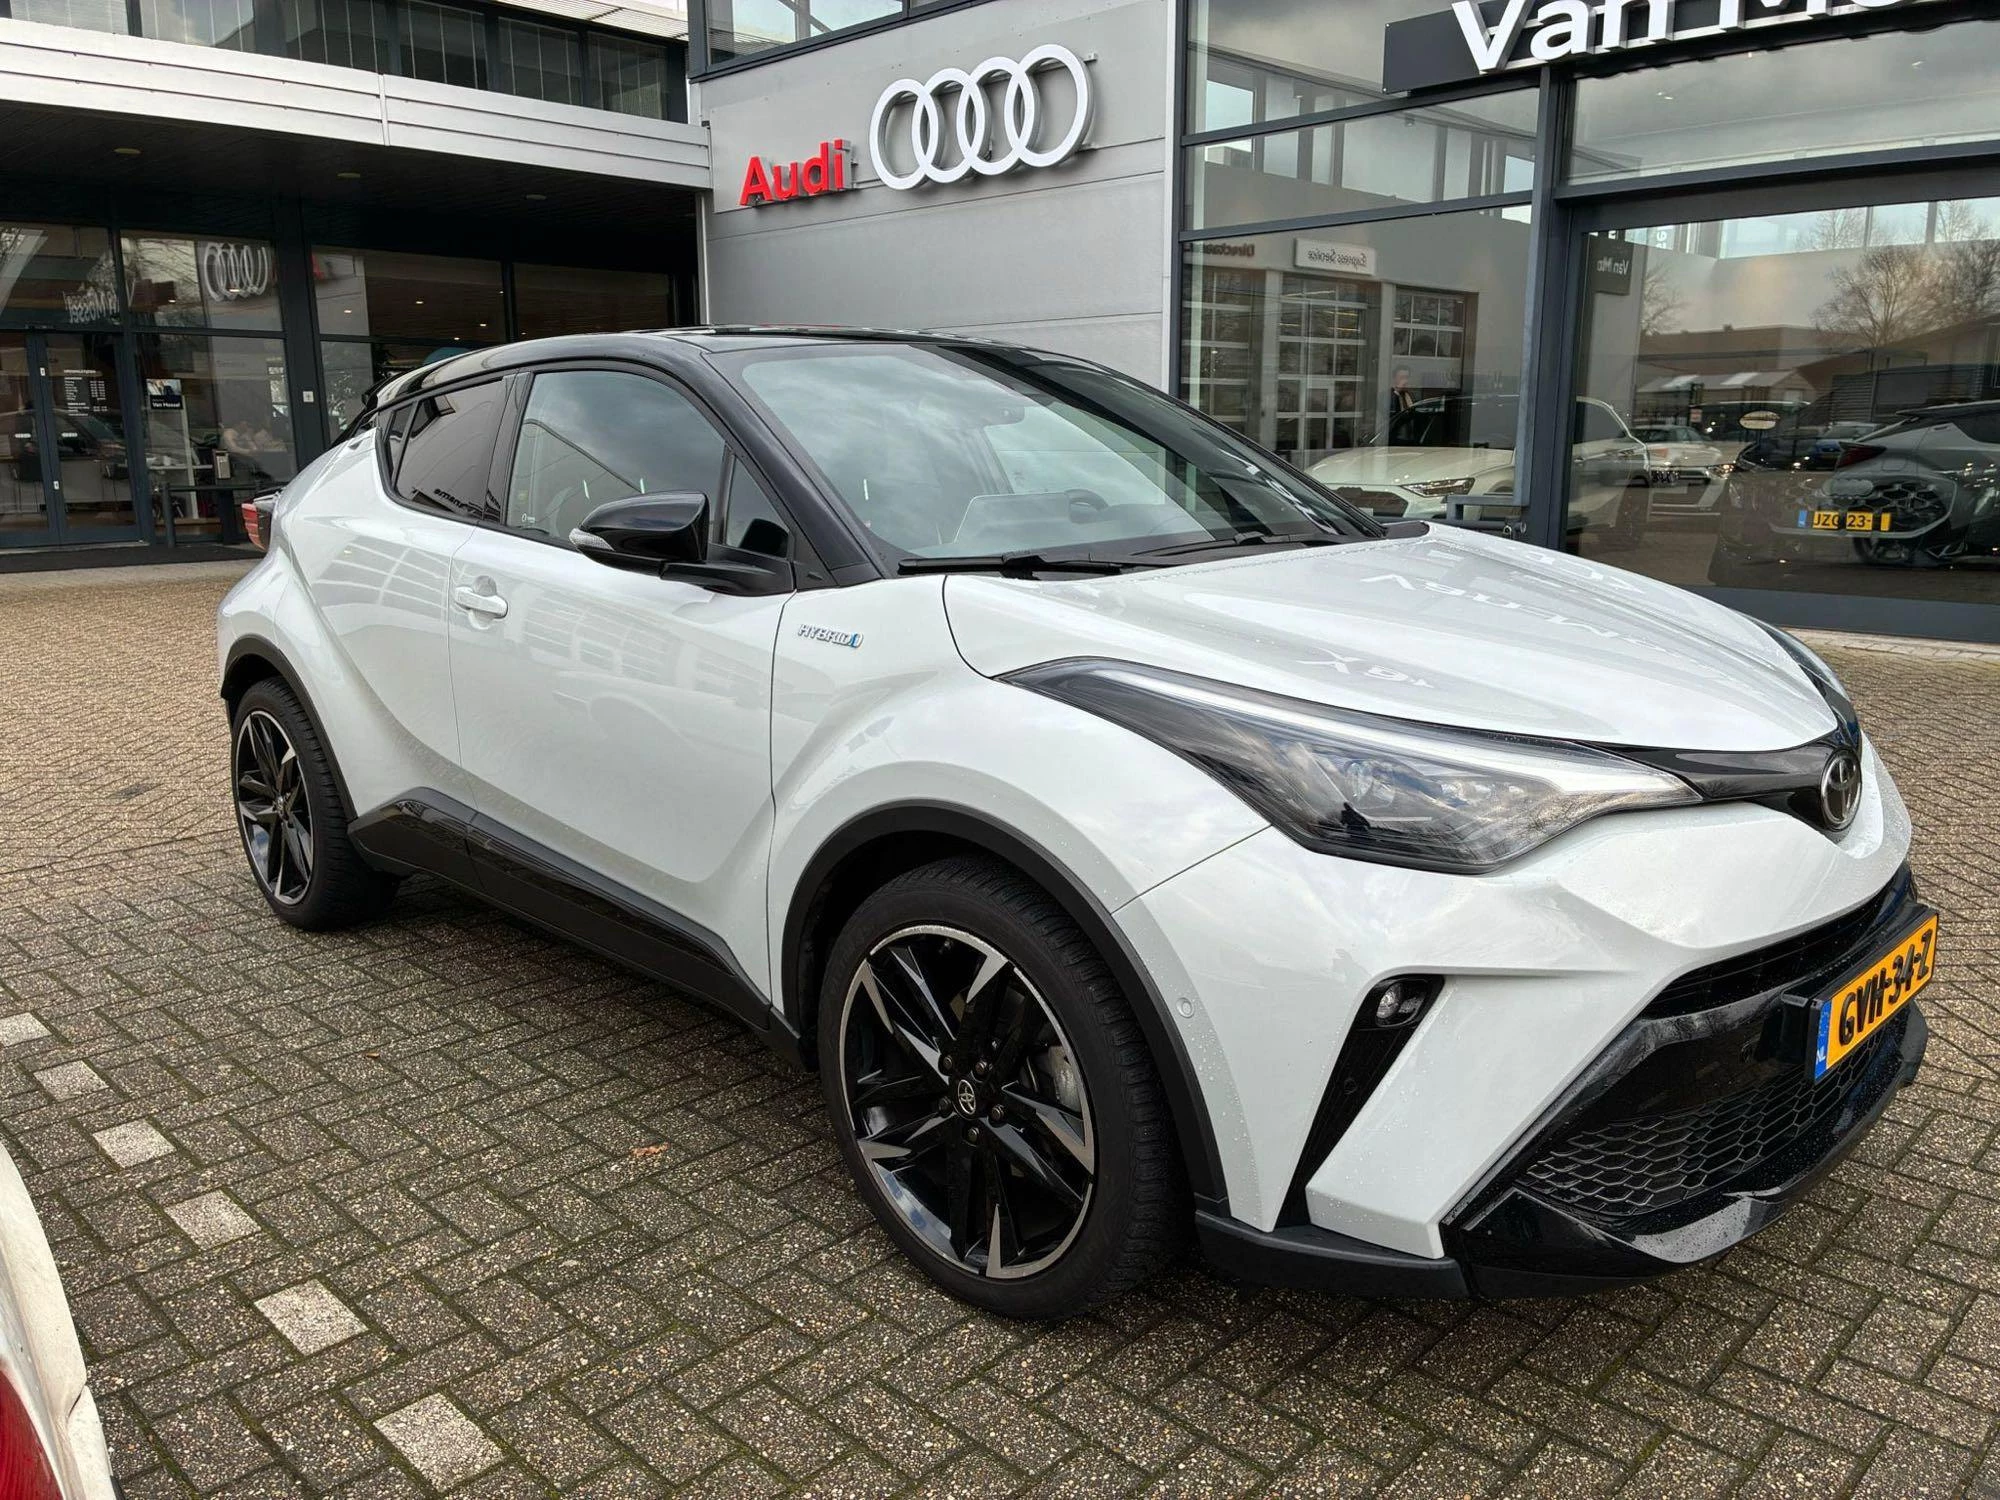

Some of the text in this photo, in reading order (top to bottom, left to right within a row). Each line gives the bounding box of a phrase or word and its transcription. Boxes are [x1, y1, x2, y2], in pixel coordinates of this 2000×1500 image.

[1452, 0, 1661, 73] Van
[739, 138, 845, 206] Audi
[798, 623, 857, 648] HYBRID
[1839, 928, 1934, 1047] GVH-34-Z
